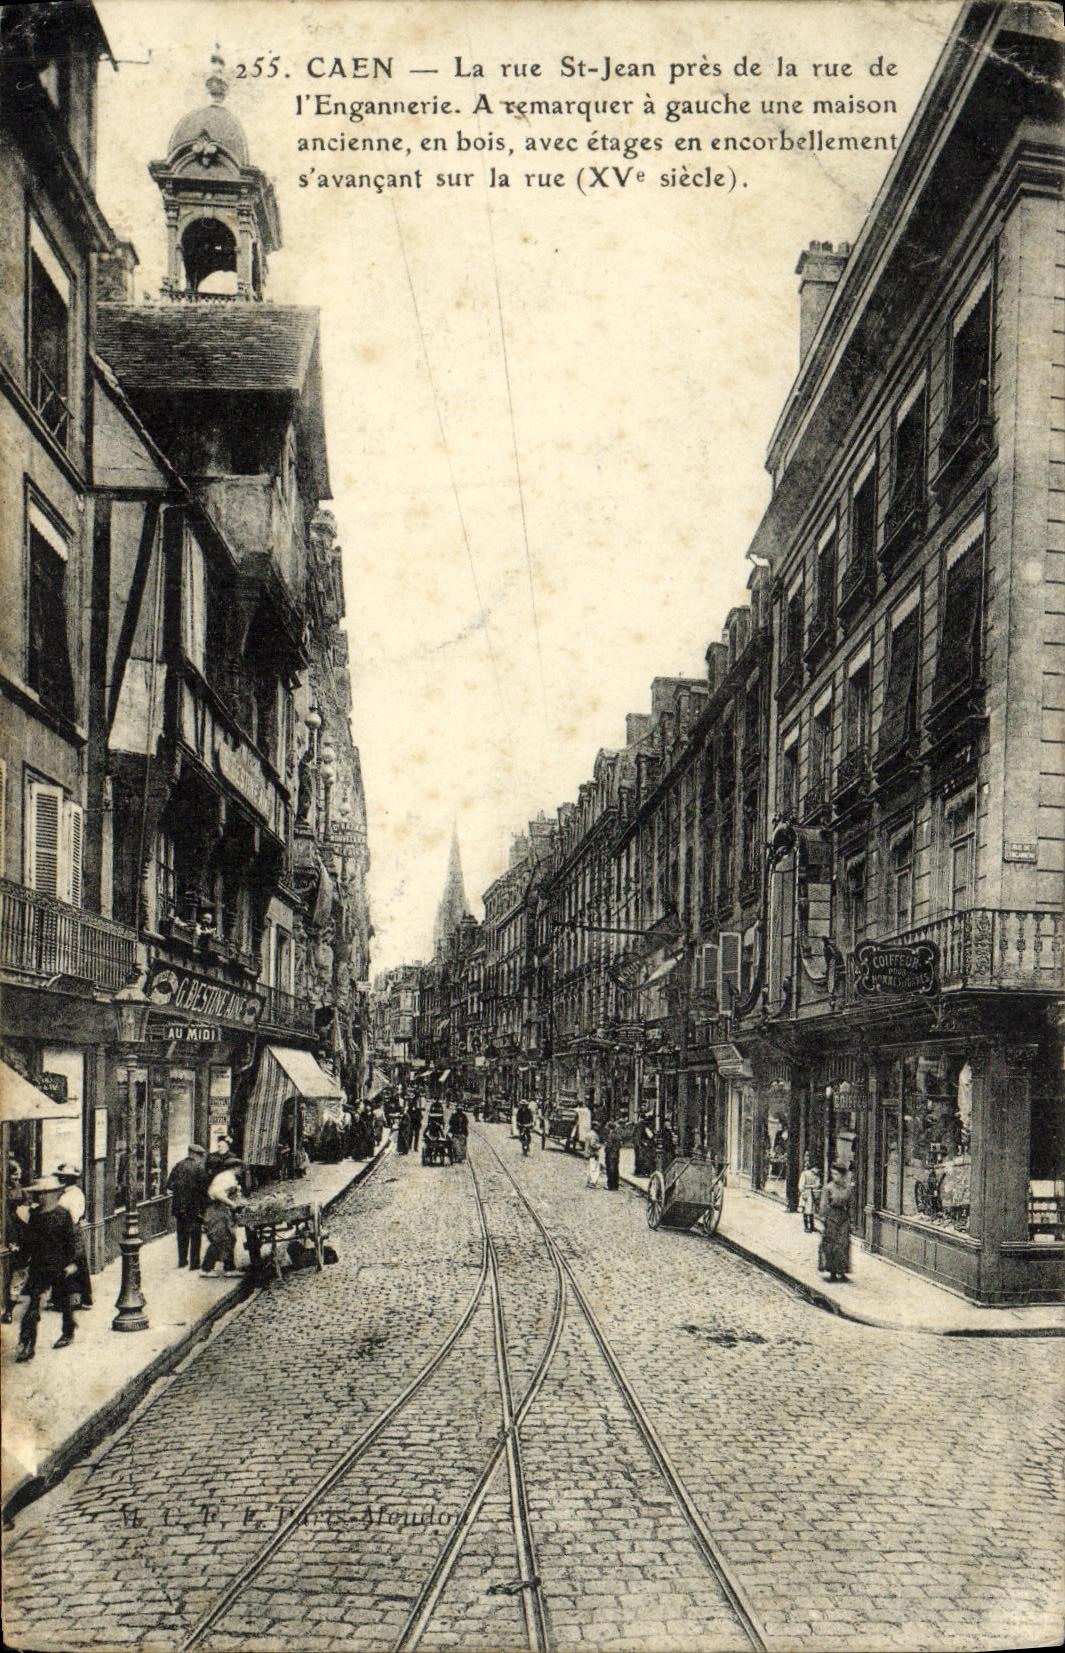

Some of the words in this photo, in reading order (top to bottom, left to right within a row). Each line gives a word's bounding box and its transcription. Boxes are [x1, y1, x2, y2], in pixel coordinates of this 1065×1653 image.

[872, 954, 920, 970] COIFFEUR
[168, 1027, 184, 1040] AU
[186, 1028, 216, 1041] MIDI
